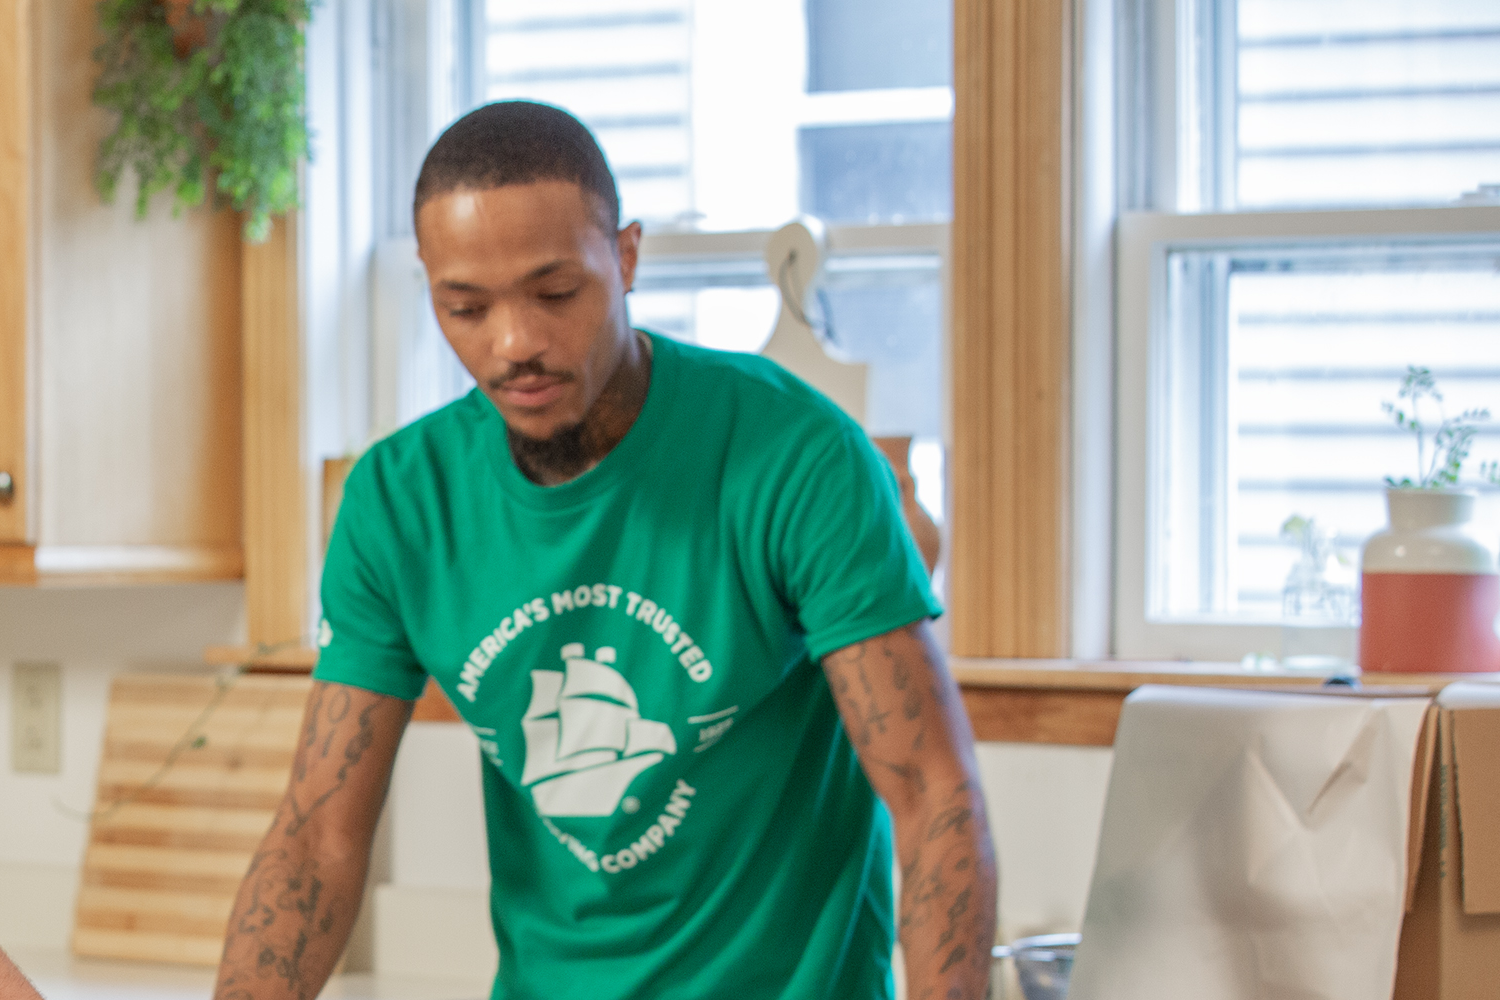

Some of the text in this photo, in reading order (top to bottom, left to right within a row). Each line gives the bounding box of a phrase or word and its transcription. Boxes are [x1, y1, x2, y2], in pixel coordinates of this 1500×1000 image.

[456, 582, 713, 703] AMERICA'S MOST TRUSTED
[600, 778, 697, 874] COMPANY
